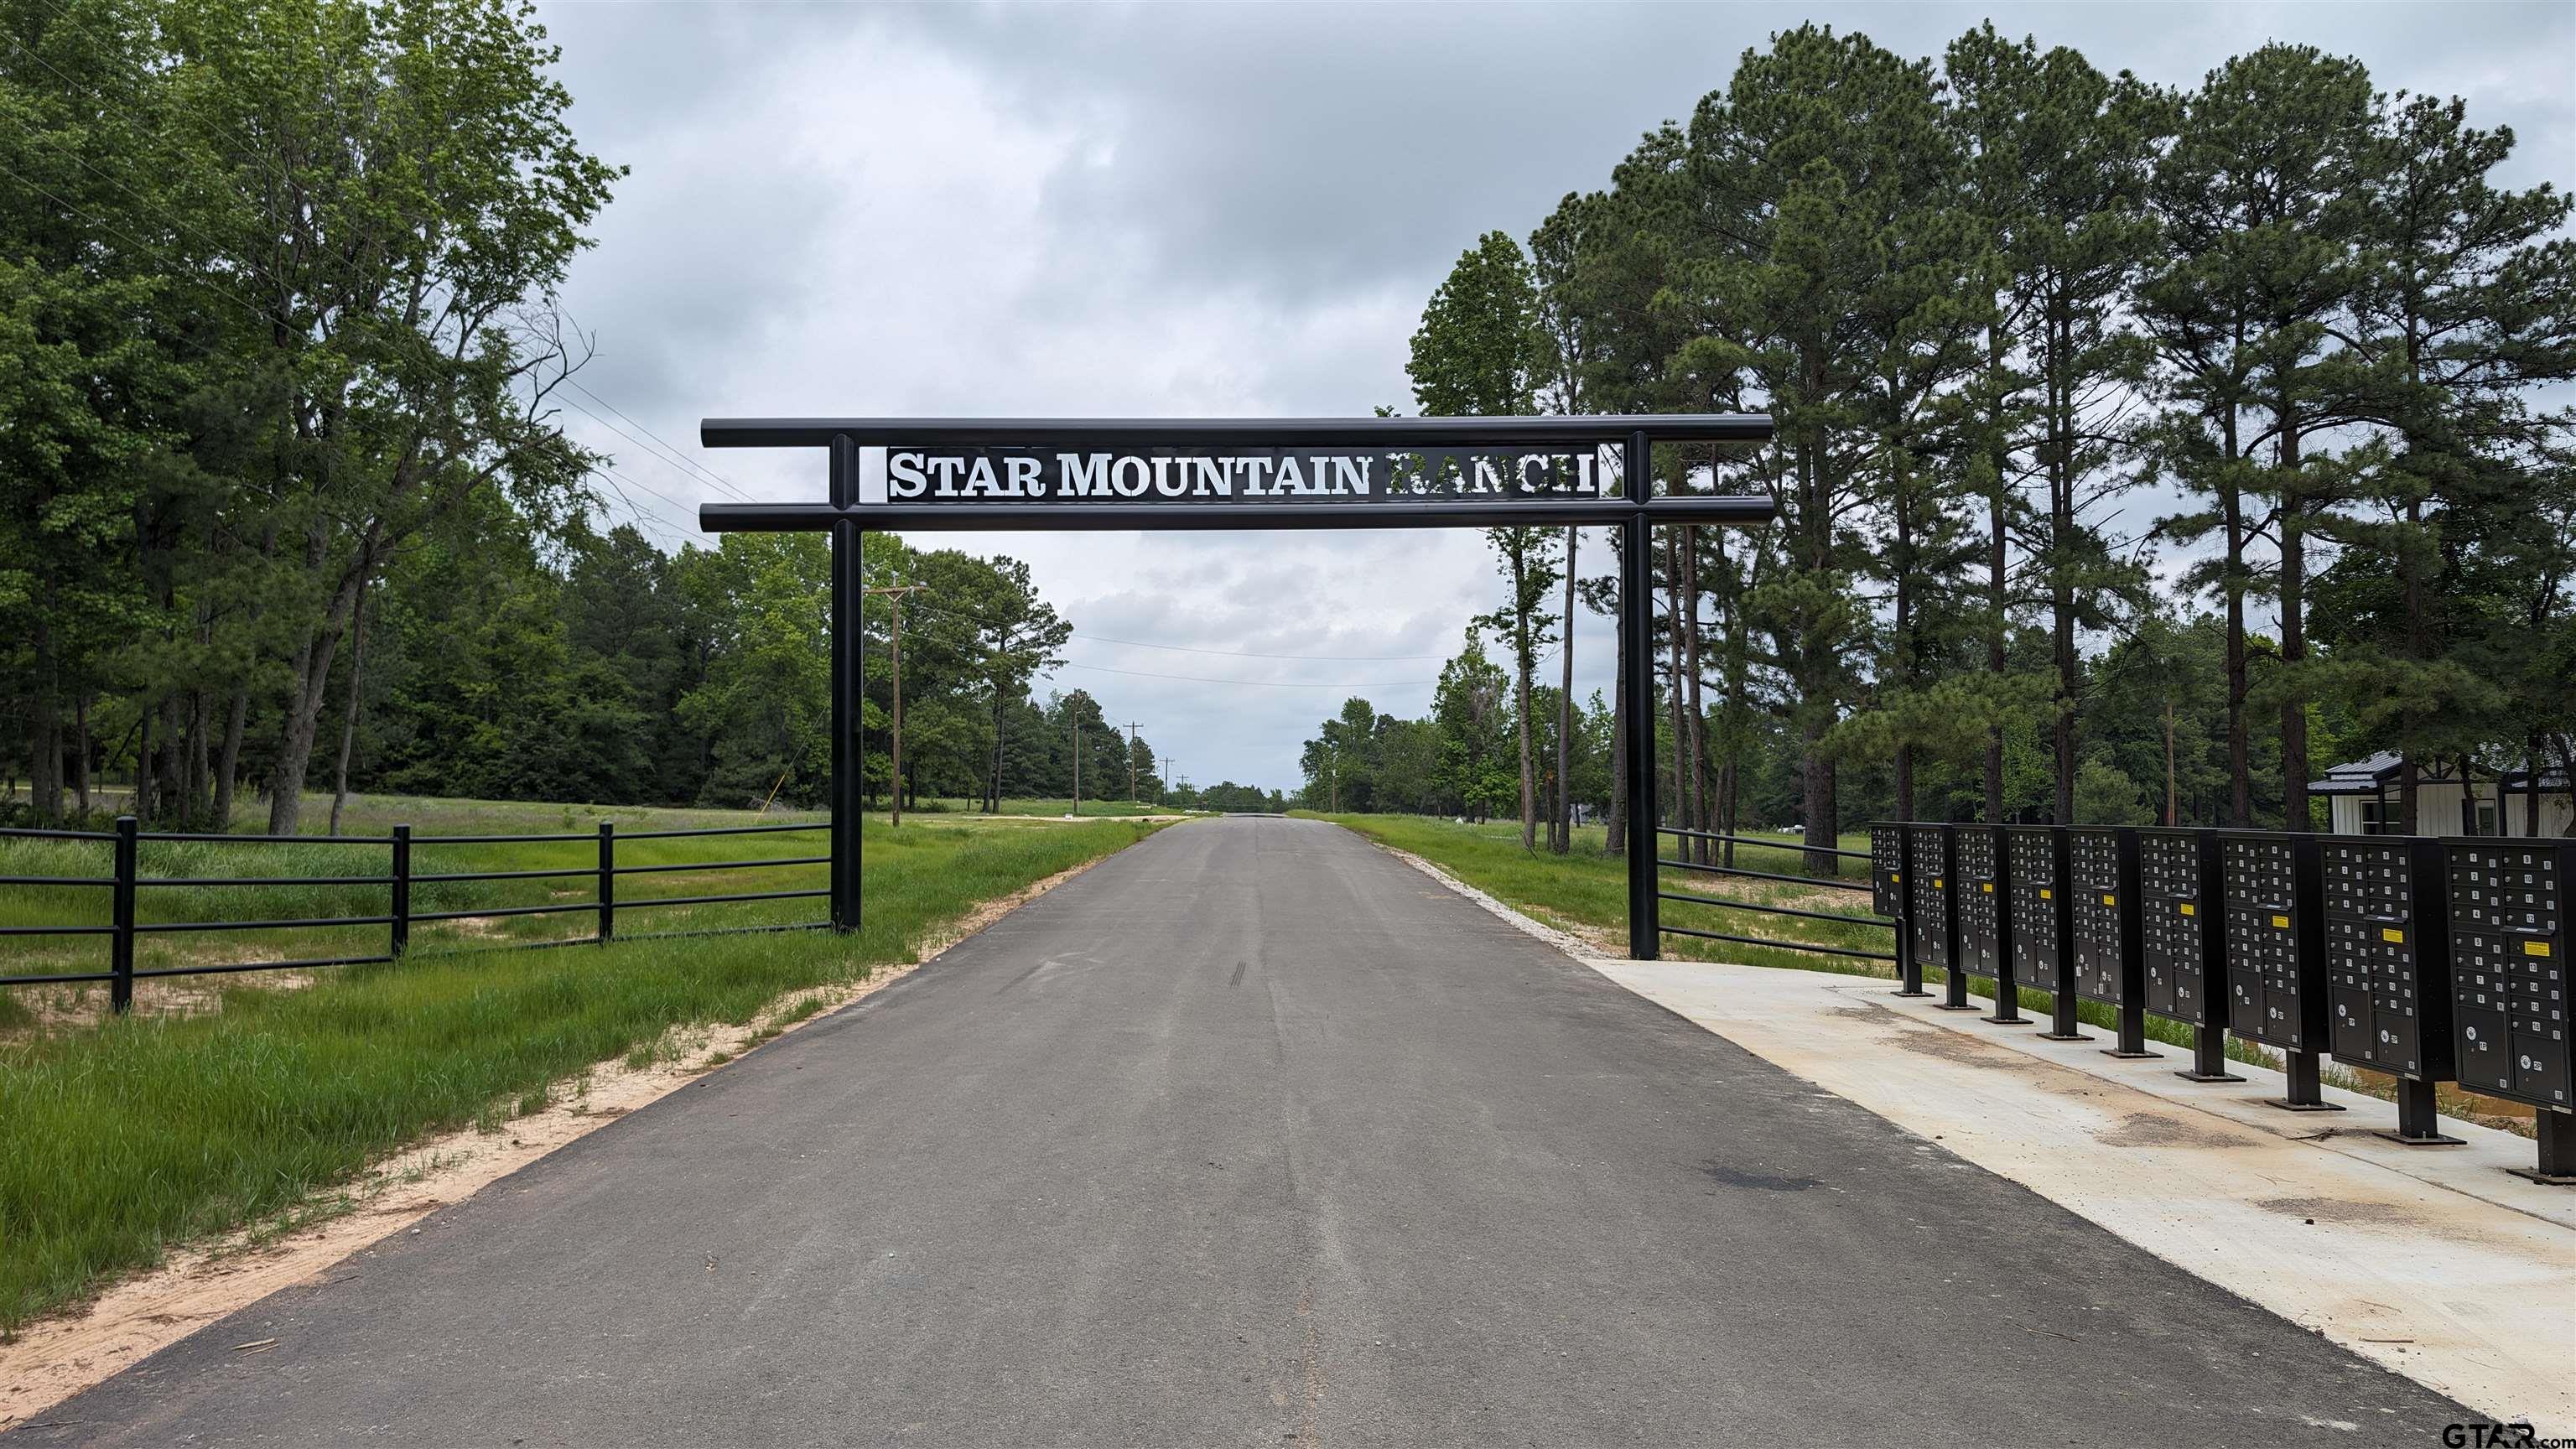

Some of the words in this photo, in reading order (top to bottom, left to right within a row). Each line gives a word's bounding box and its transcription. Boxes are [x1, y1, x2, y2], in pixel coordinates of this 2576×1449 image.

[890, 453, 1046, 496] STAR
[1057, 453, 1374, 496] MOUNTAIN
[1386, 452, 1595, 494] RANCH
